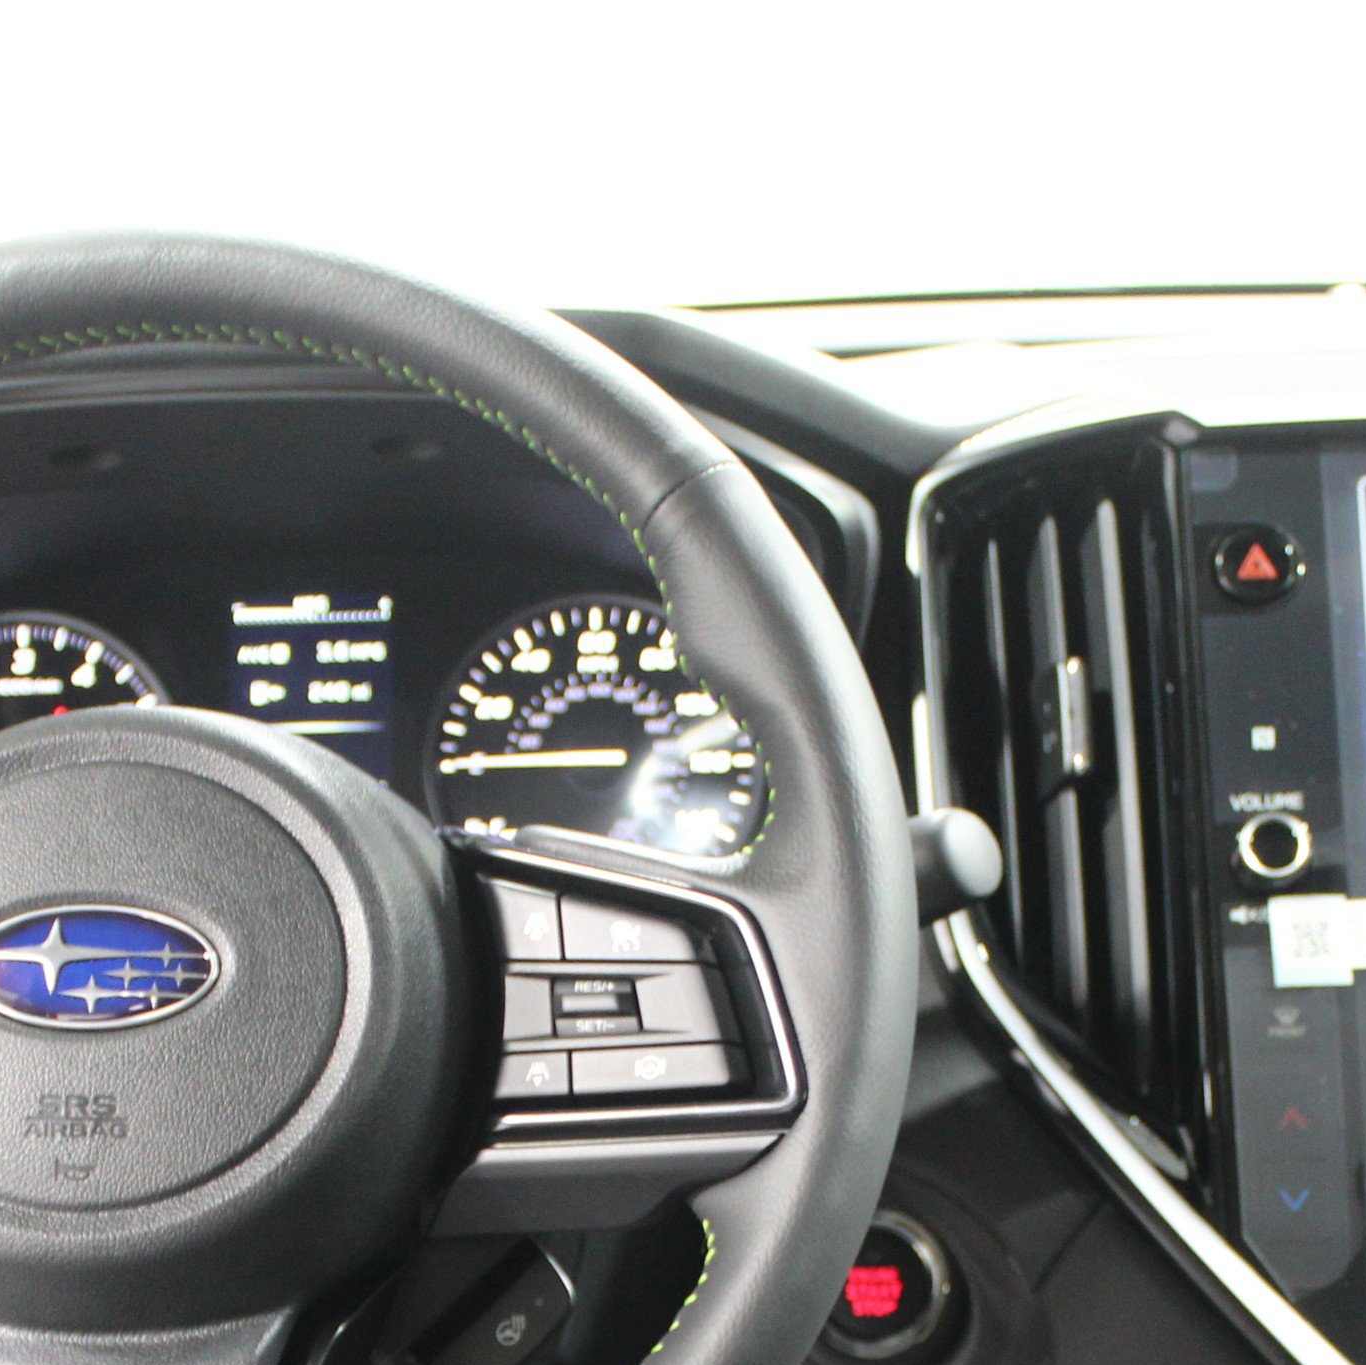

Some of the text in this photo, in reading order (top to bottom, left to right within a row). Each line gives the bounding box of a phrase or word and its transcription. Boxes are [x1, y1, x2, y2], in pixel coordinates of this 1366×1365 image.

[1228, 790, 1304, 812] VOLUME
[38, 1093, 118, 1119] SRS
[24, 1118, 129, 1139] AIRBAG
